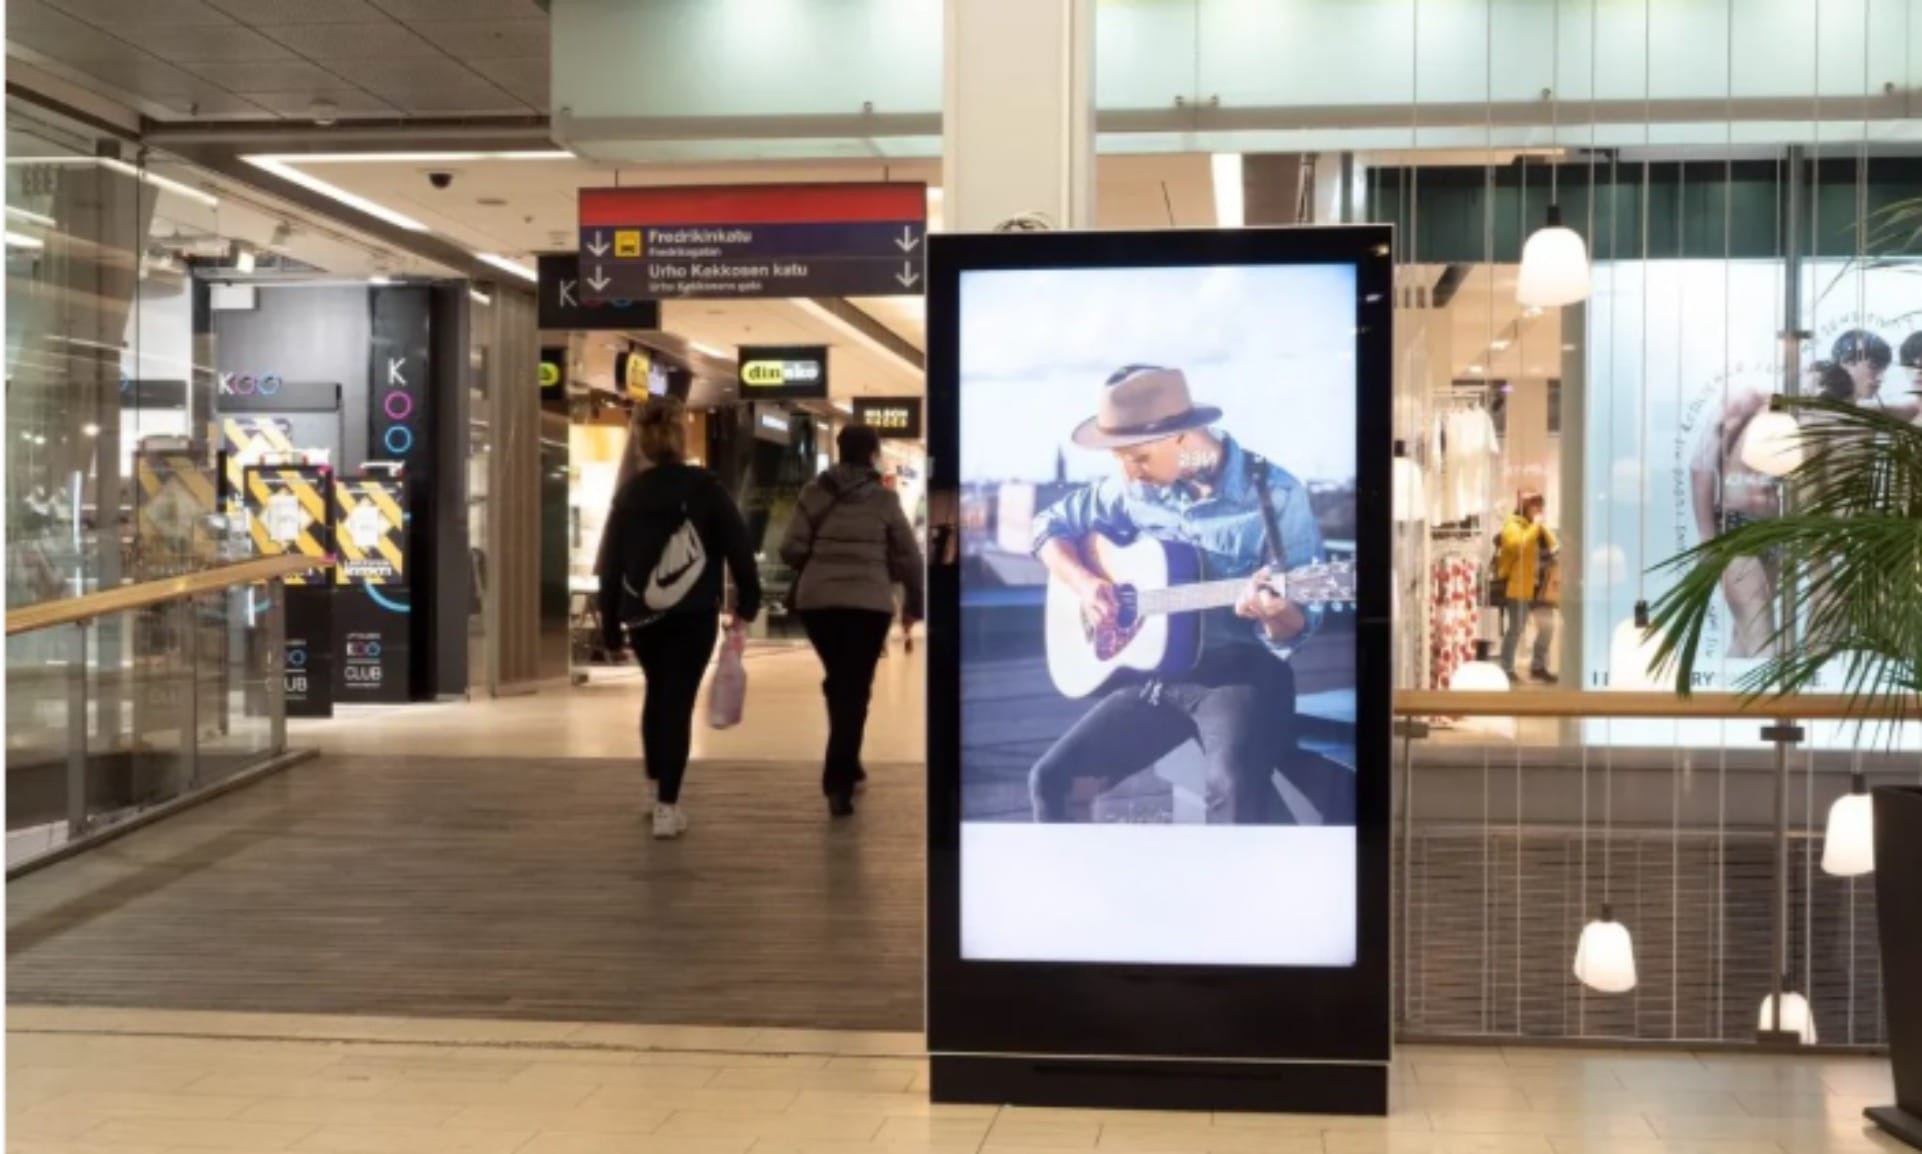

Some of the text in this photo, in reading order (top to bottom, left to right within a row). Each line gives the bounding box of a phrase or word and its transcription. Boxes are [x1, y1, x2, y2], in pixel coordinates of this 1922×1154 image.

[648, 229, 752, 243] Fredrikinkatu
[648, 262, 808, 278] Urho Kekkosen katu
[344, 666, 383, 681] CLUB
